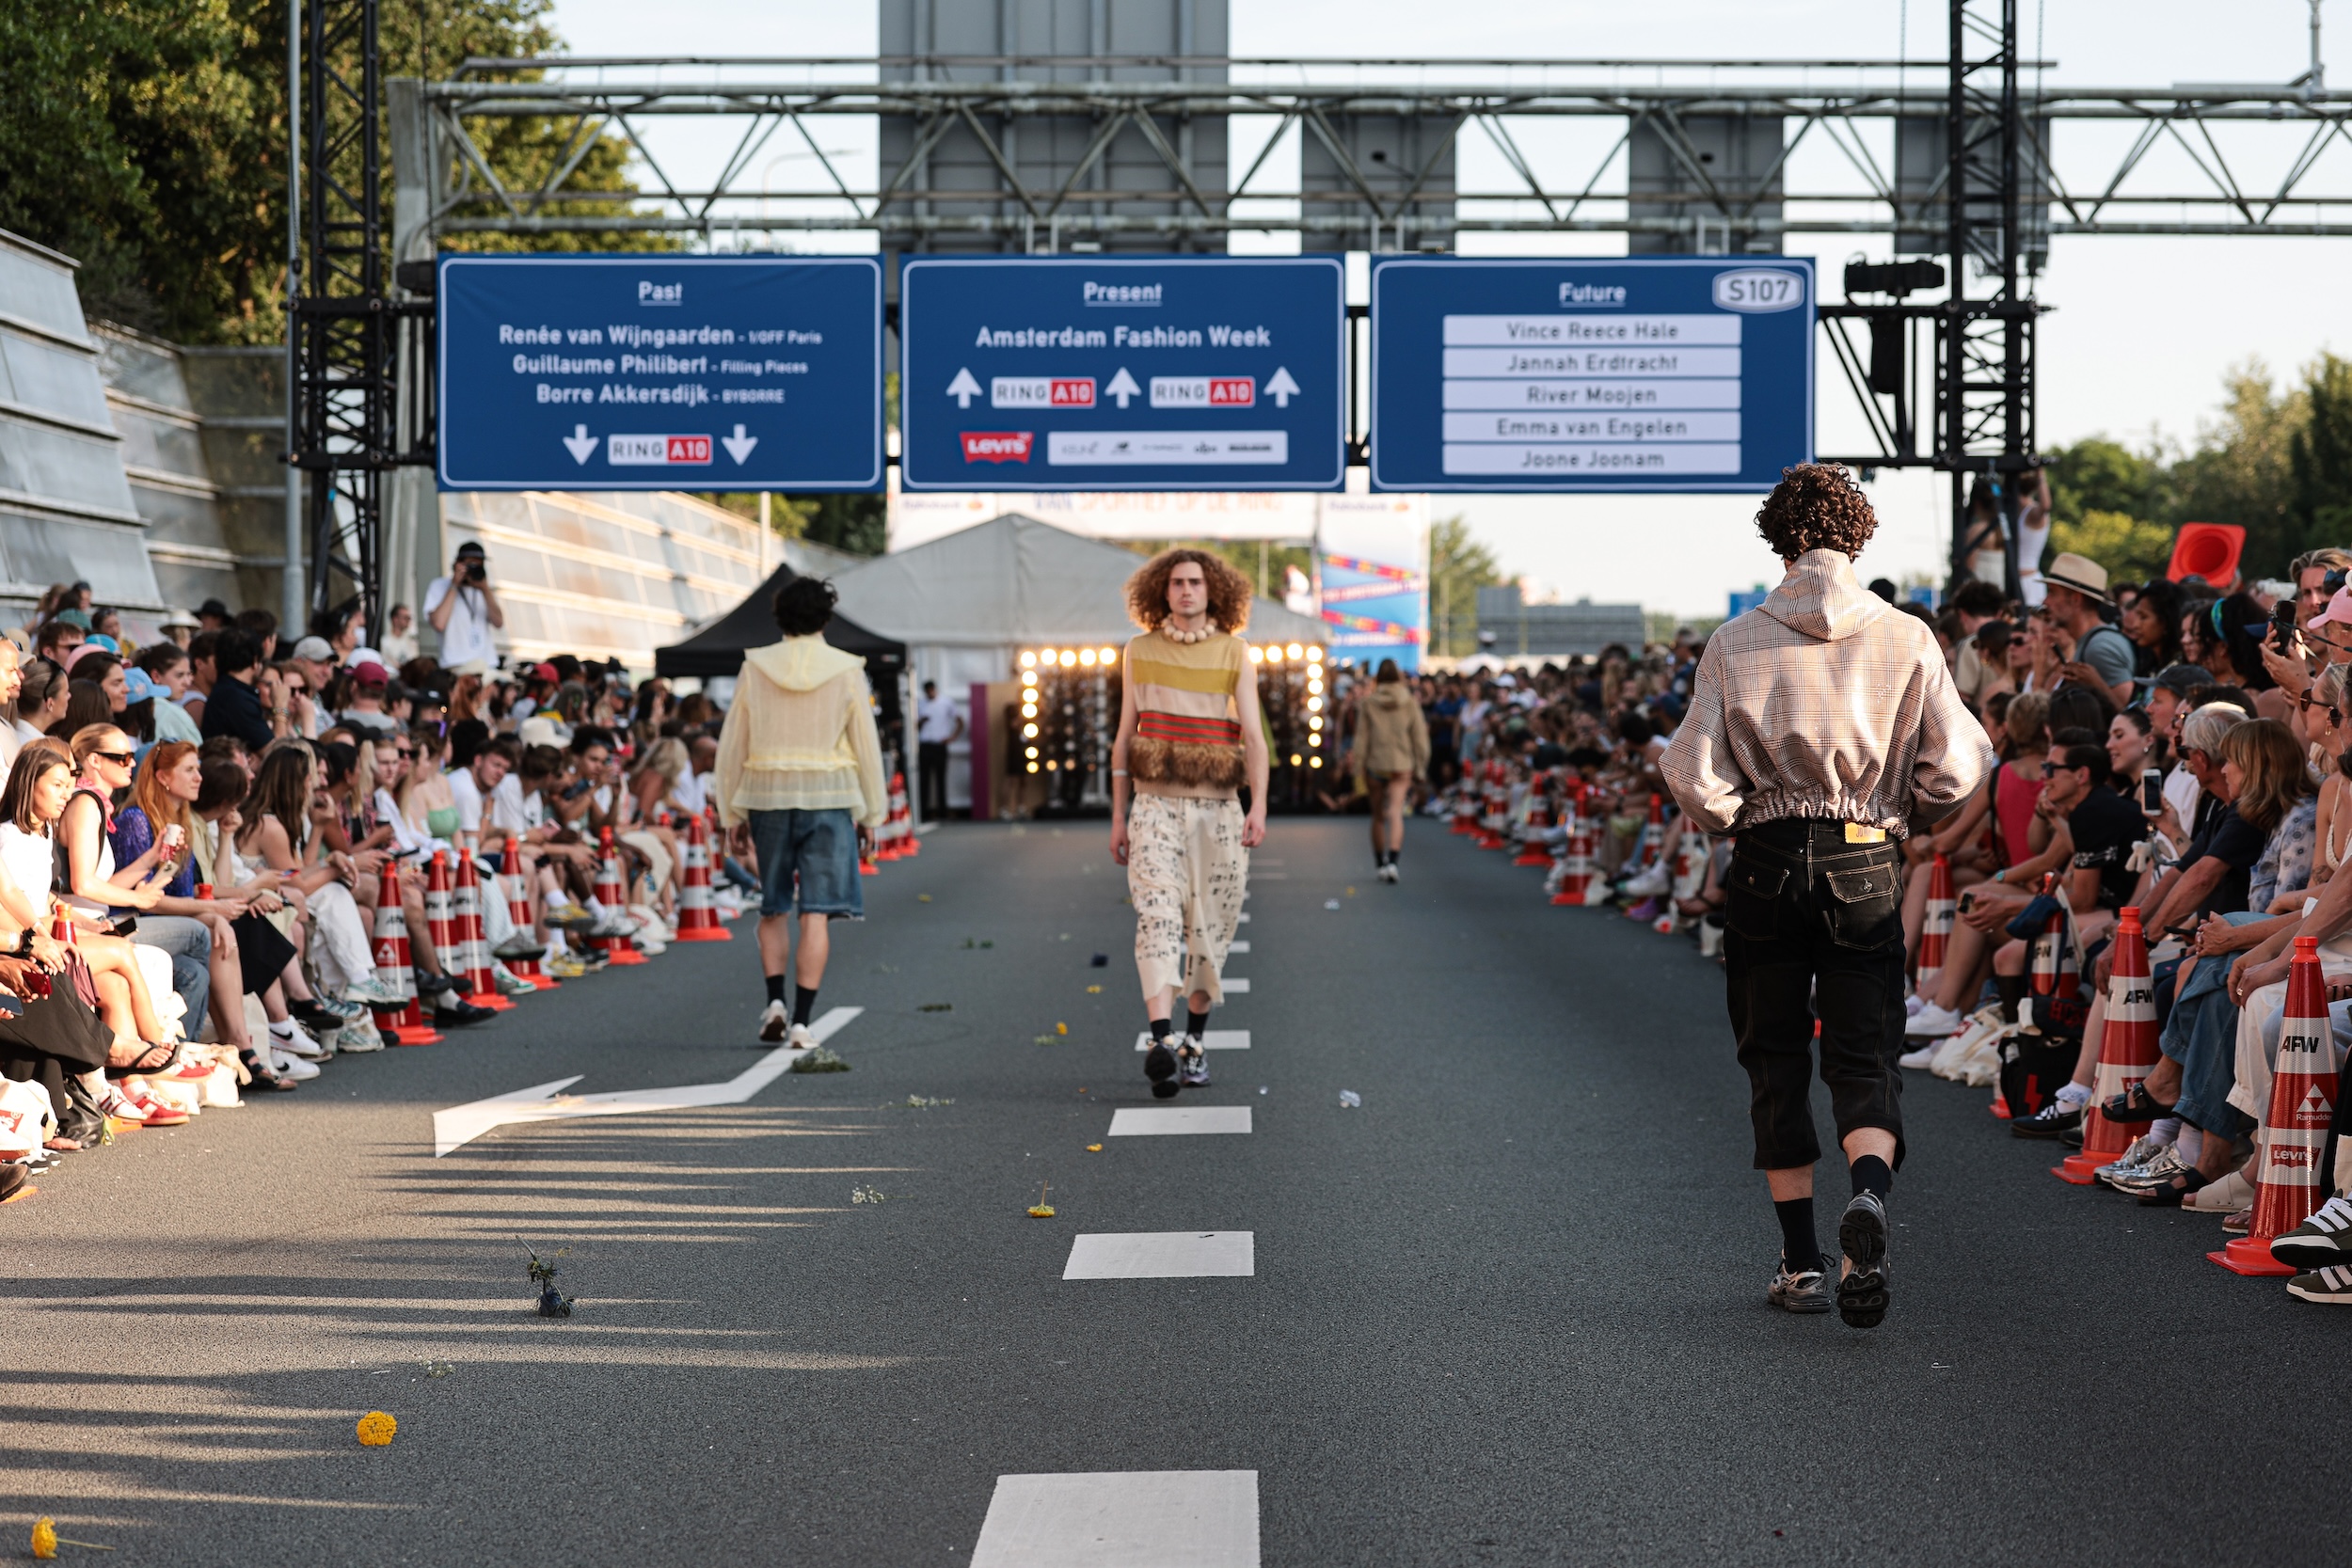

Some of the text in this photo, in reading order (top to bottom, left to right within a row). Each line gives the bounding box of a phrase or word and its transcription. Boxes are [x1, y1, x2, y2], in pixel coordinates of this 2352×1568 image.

[639, 281, 683, 300] Past
[1084, 281, 1162, 301] Present
[1559, 282, 1627, 301] Future
[1727, 278, 1790, 302] S107
[499, 324, 562, 345] Renée
[566, 329, 603, 345] van
[608, 325, 735, 349] Wijngaarden
[787, 329, 822, 344] Paris
[976, 325, 1271, 348] Amsterdam Fashion Week
[1507, 323, 1678, 340] Vince Reece Hale
[513, 354, 615, 374] Guillaume
[621, 354, 707, 374] Philibert
[721, 359, 762, 376] Filling
[765, 359, 808, 374] Pieces
[1508, 354, 1678, 372] Jannah Erdtracht
[536, 384, 594, 404] Borre
[598, 384, 709, 407] Akkersdijk
[722, 388, 785, 404] BYBORRE
[996, 384, 1091, 403] RING A10
[1154, 383, 1251, 402] RING A10
[1528, 387, 1657, 407] River Moojen
[1497, 419, 1687, 439] Emma van Engelen
[612, 440, 708, 460] RING A10
[1521, 451, 1664, 468] Joone Joonam
[2123, 990, 2153, 1005] AFW
[2280, 1036, 2319, 1053] AFW
